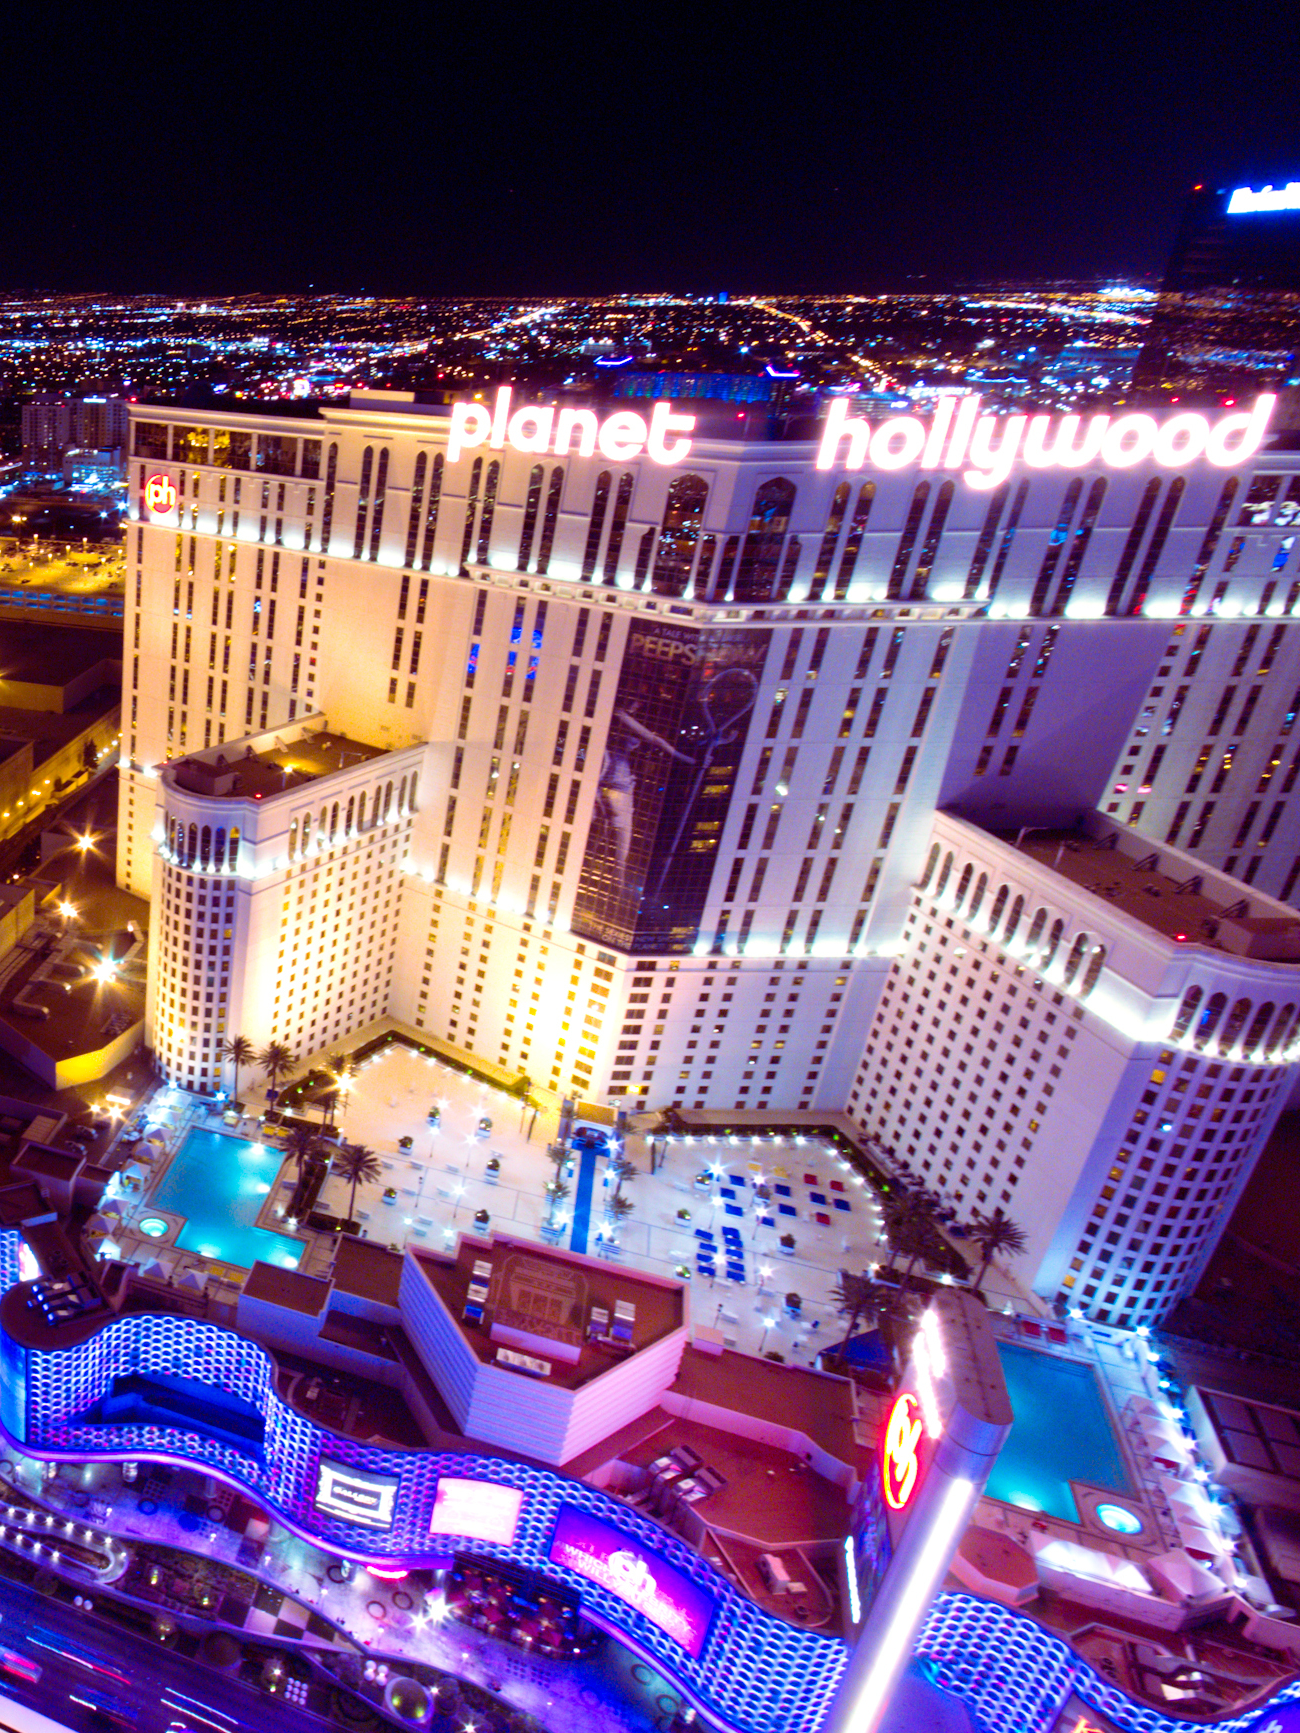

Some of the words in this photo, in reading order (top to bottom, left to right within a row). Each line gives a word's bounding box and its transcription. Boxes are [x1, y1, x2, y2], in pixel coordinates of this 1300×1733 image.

[446, 385, 697, 464] planet
[815, 392, 1278, 491] hollywood
[147, 474, 177, 511] ph
